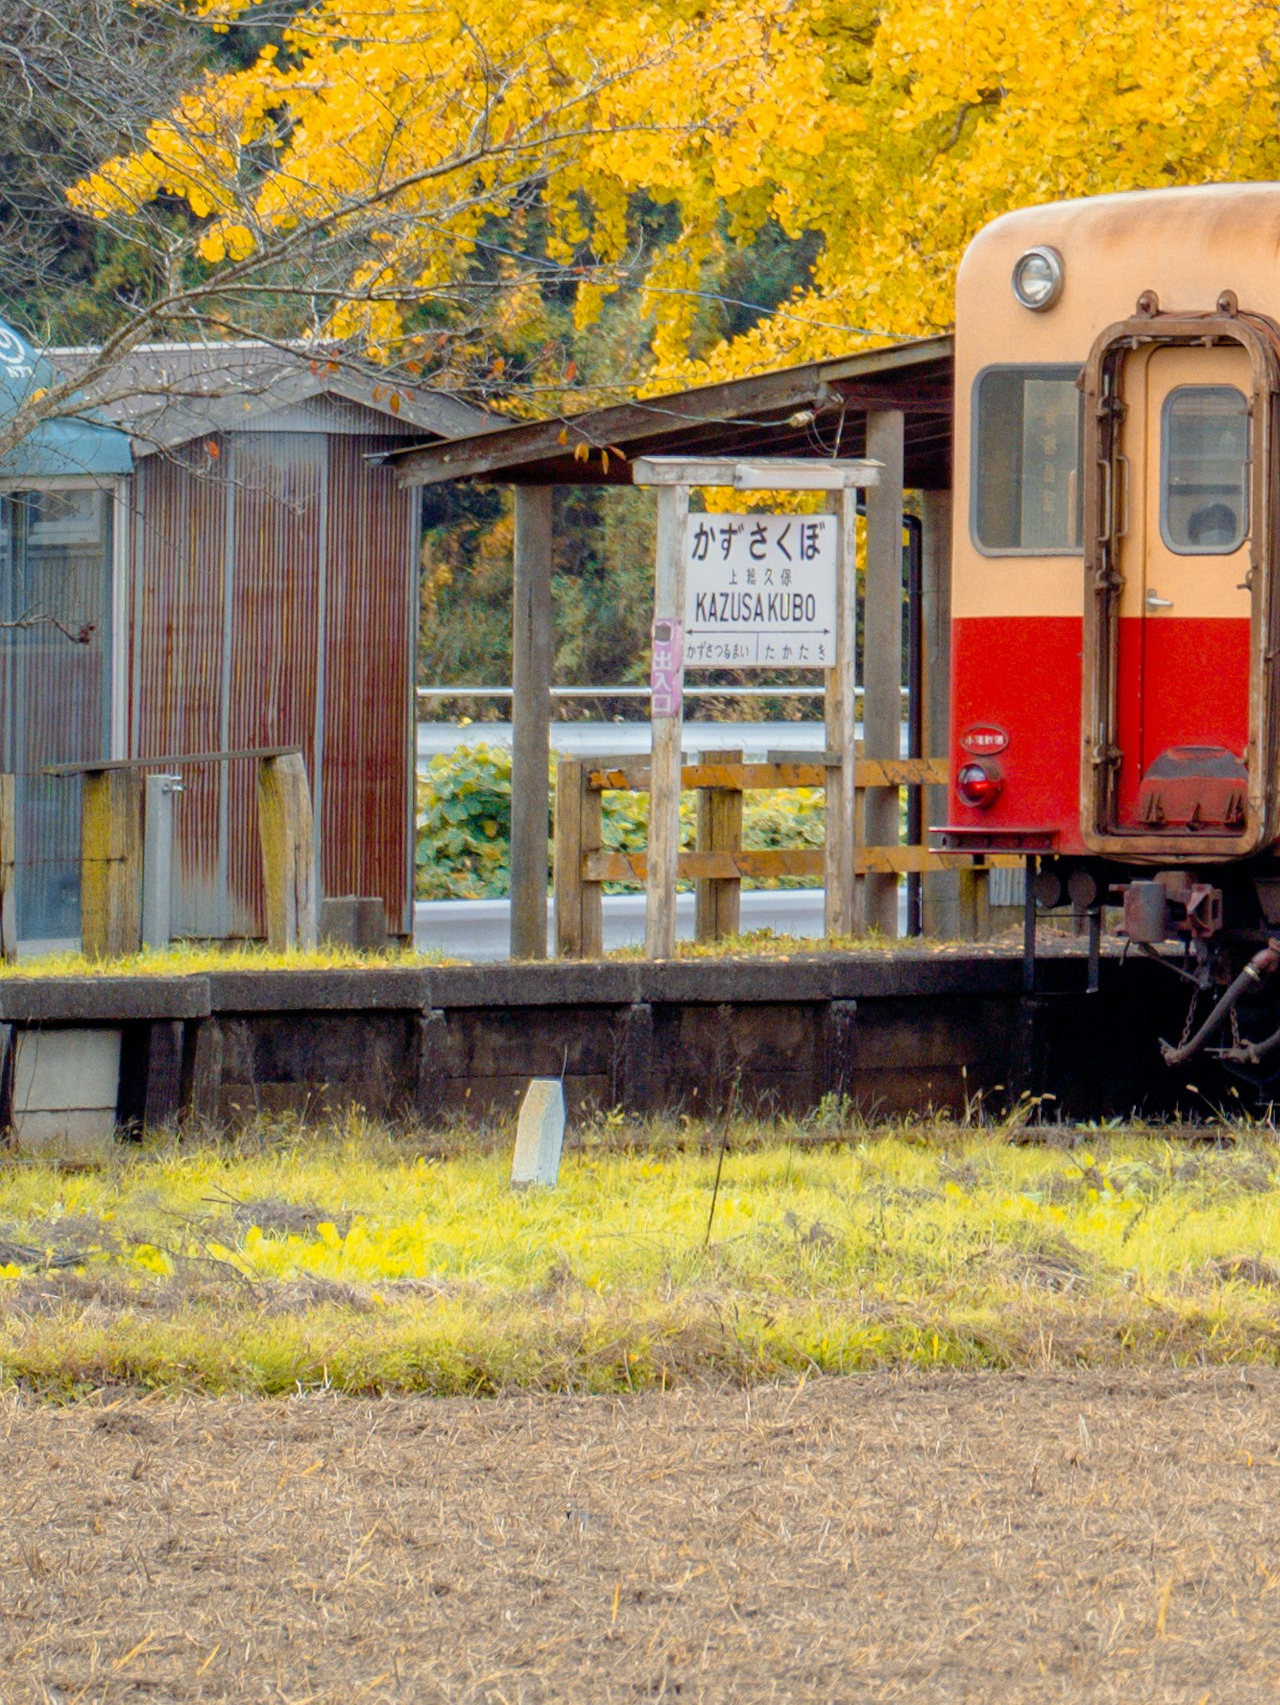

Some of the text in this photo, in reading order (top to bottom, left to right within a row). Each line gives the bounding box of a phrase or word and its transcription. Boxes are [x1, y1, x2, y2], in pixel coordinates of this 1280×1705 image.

[691, 521, 825, 561] かずさくぼ
[728, 568, 793, 586] 上総久保
[695, 592, 816, 623] KAZUSAKUBO
[686, 641, 750, 660] かずさつるまい
[764, 643, 827, 661] たかたき
[652, 647, 673, 713] 出入口
